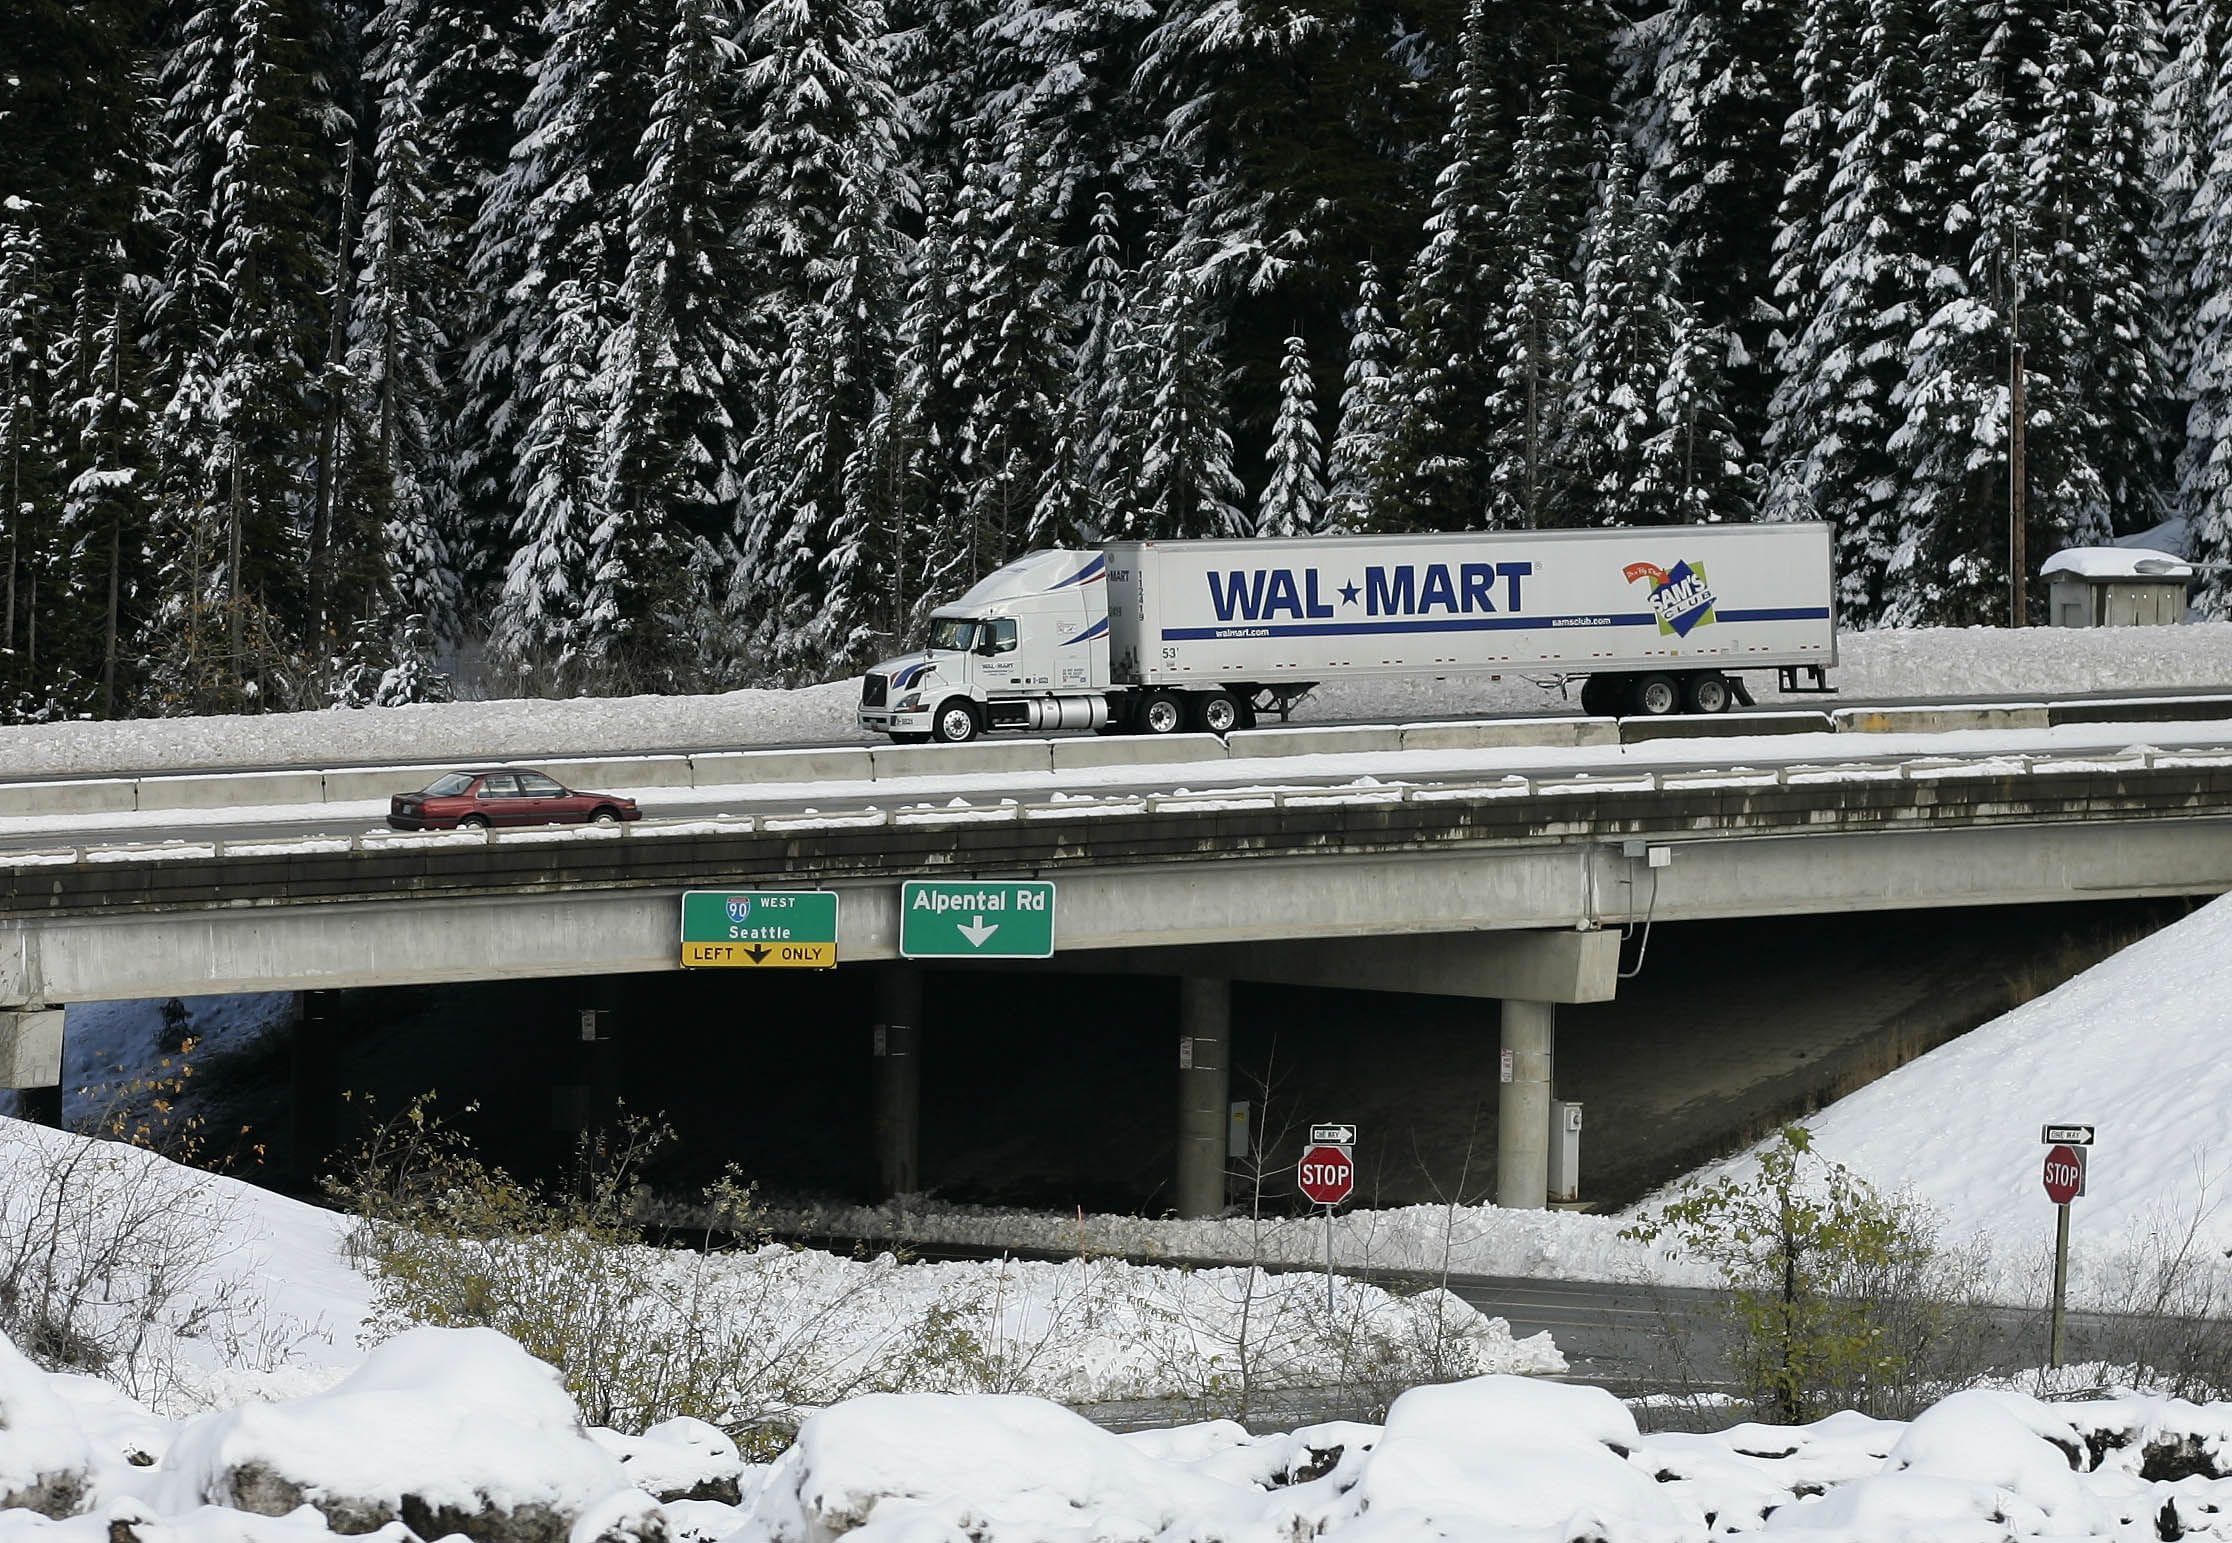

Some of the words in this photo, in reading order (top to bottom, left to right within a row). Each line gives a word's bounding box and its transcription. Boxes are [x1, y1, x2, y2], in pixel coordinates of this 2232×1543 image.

[1206, 568, 1335, 621] WAL
[1365, 561, 1533, 617] MART
[1649, 573, 1705, 613] SAM'S
[1663, 590, 1712, 619] CLUB
[1552, 616, 1612, 627] samsclub.com
[1216, 628, 1270, 638] walmart.com
[729, 903, 748, 918] 90
[760, 897, 796, 908] WEST
[913, 889, 1006, 914] Alpental
[1016, 890, 1045, 911] Rd
[729, 925, 791, 939] Seattle
[694, 947, 734, 960] LEFT
[781, 947, 823, 960] ONLY
[1302, 1164, 1349, 1186] STOP
[2046, 1162, 2079, 1187] STOP
